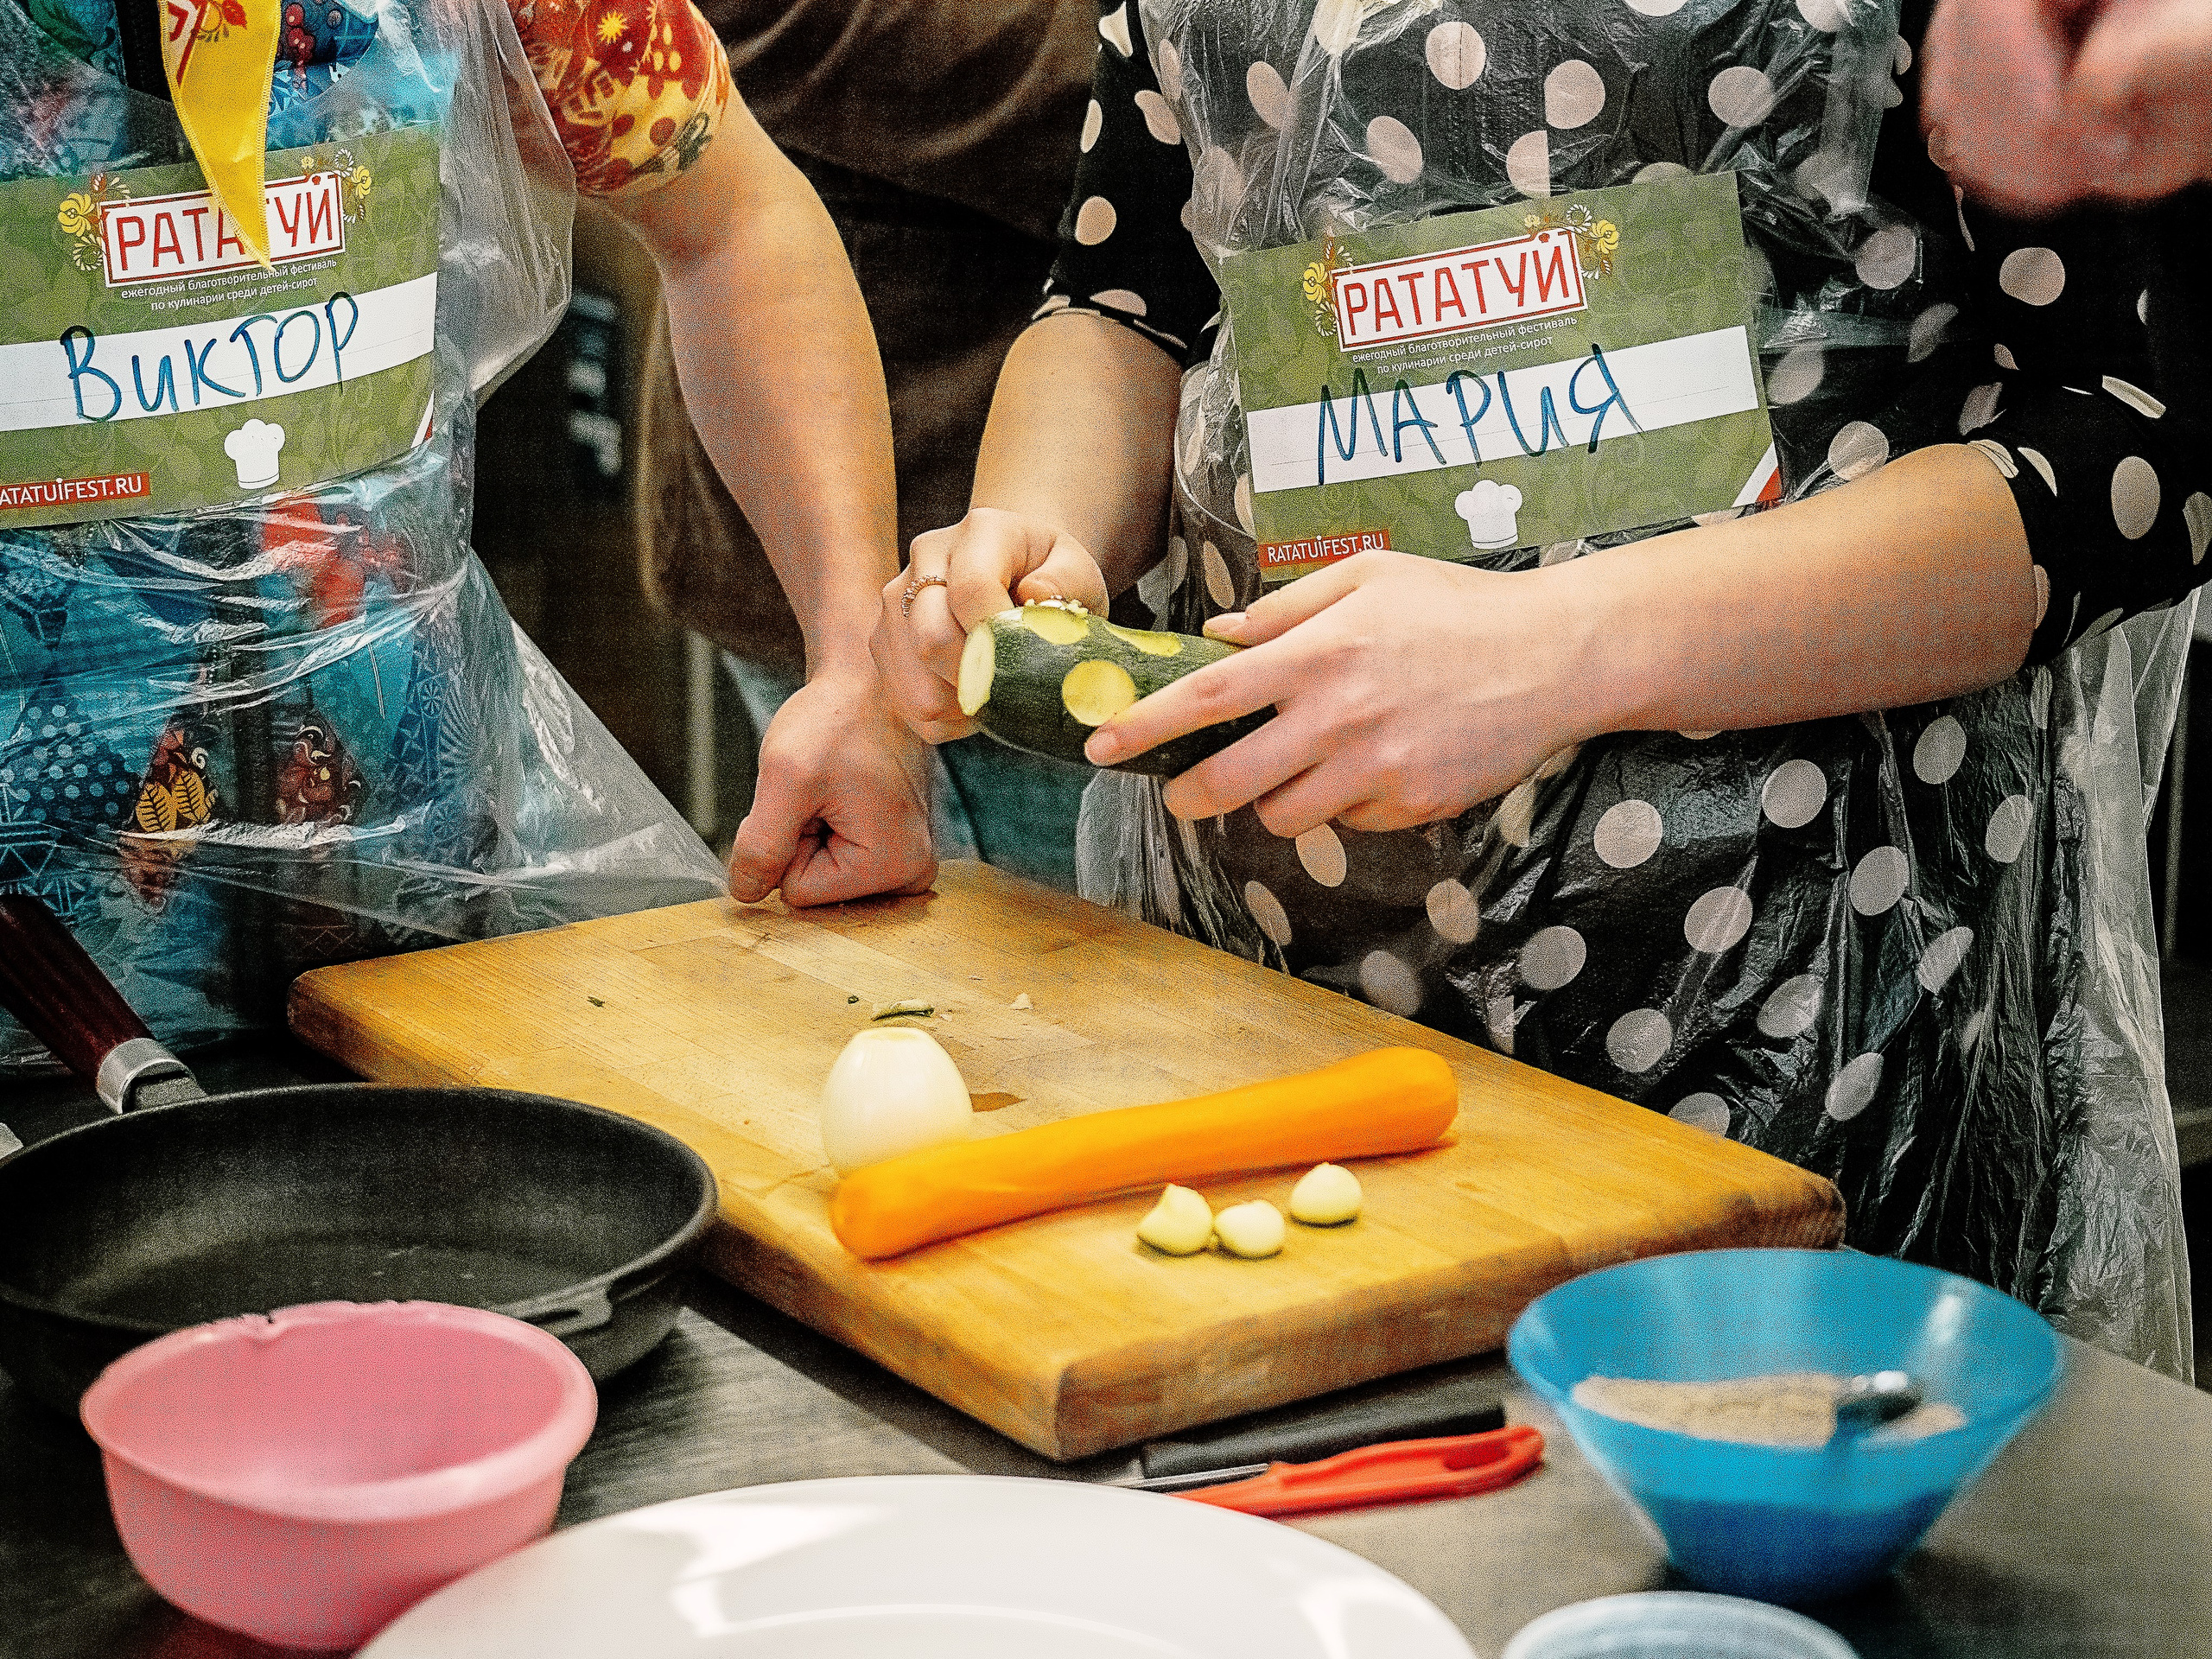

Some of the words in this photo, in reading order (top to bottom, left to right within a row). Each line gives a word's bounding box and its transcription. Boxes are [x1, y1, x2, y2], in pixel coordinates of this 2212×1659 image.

[116, 175, 334, 271] РАТАУЙ
[121, 281, 187, 300] ежегодный
[188, 269, 289, 290] благотворительный
[289, 258, 338, 277] фестиваль
[150, 300, 168, 312] по
[168, 290, 226, 309] кулинарии
[226, 285, 258, 302] среди
[259, 277, 318, 297] детей-сирот
[1344, 232, 1570, 336] РАТАТУЙ
[1352, 346, 1407, 363] ежегодный
[1408, 328, 1516, 353] благотворительный
[1518, 316, 1578, 338] фестиваль
[1376, 363, 1390, 375] по
[1391, 353, 1447, 373] кулинарии
[1448, 346, 1483, 364] среди
[1484, 336, 1554, 359] детей-сирот
[1318, 343, 1645, 486] МАРИЯ
